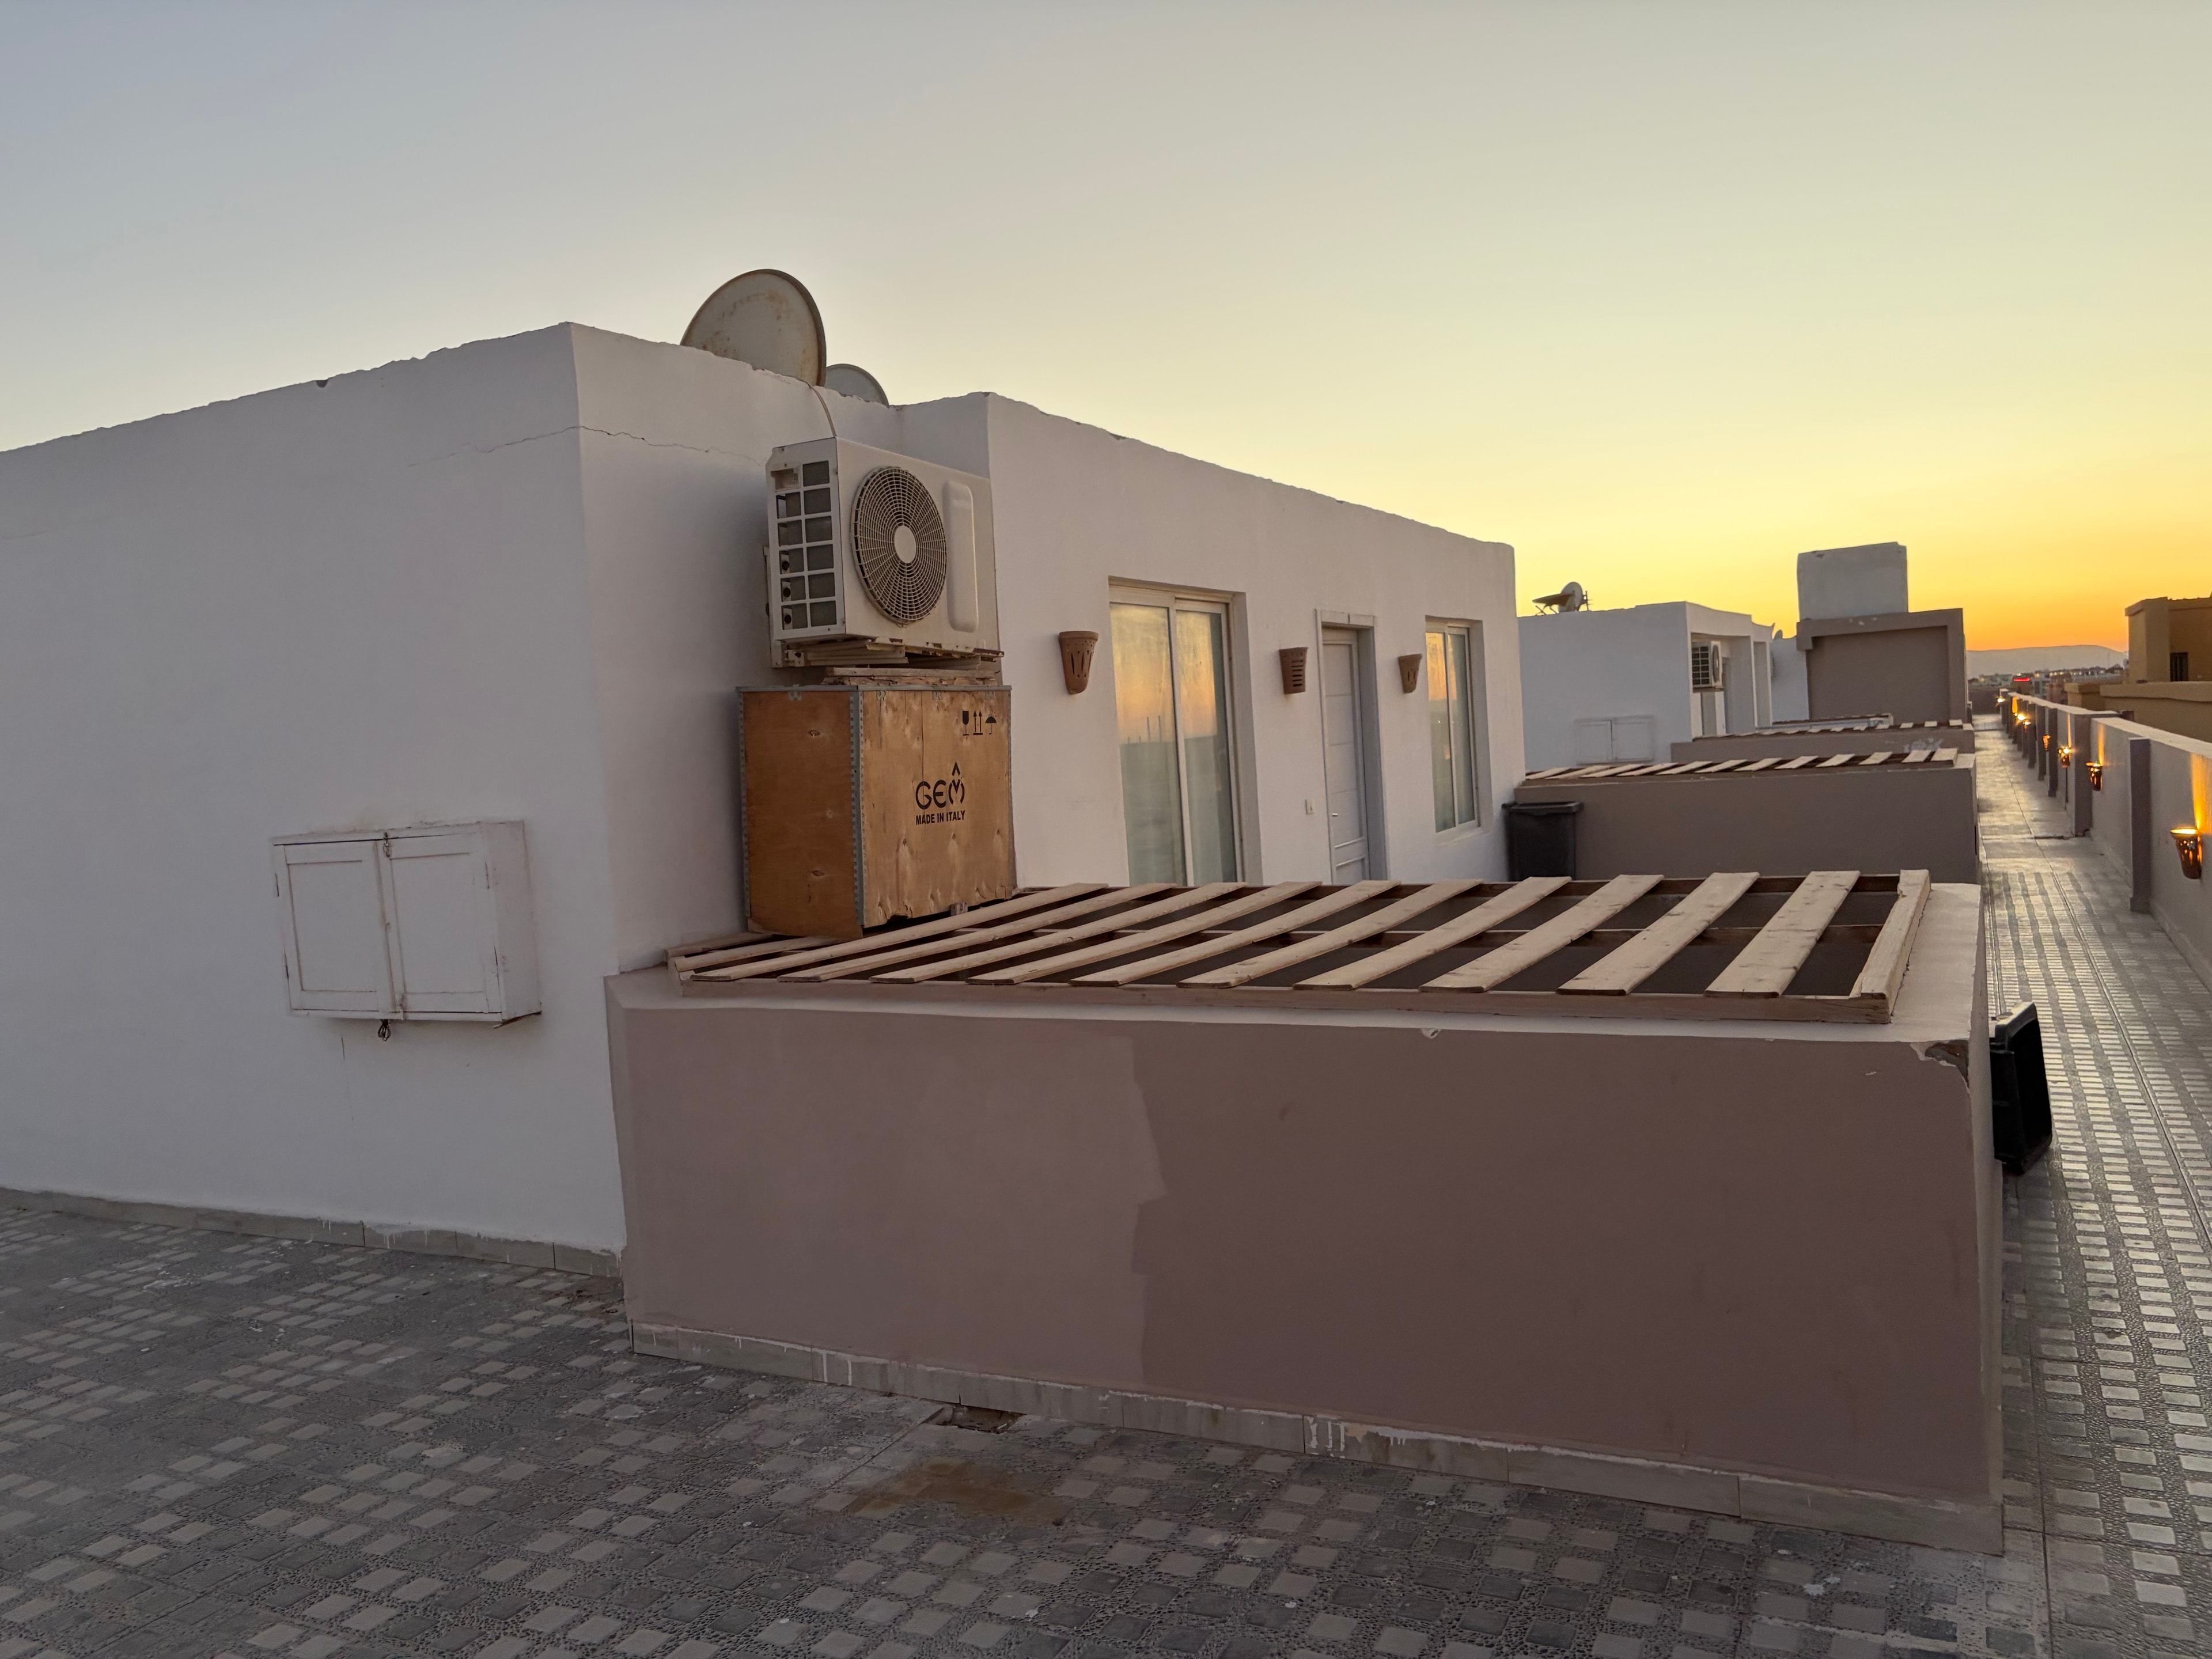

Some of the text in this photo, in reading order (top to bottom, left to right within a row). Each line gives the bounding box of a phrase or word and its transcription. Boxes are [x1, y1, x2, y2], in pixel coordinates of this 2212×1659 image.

[915, 762, 965, 810] GEM
[916, 810, 965, 825] MADE IN ITALY
